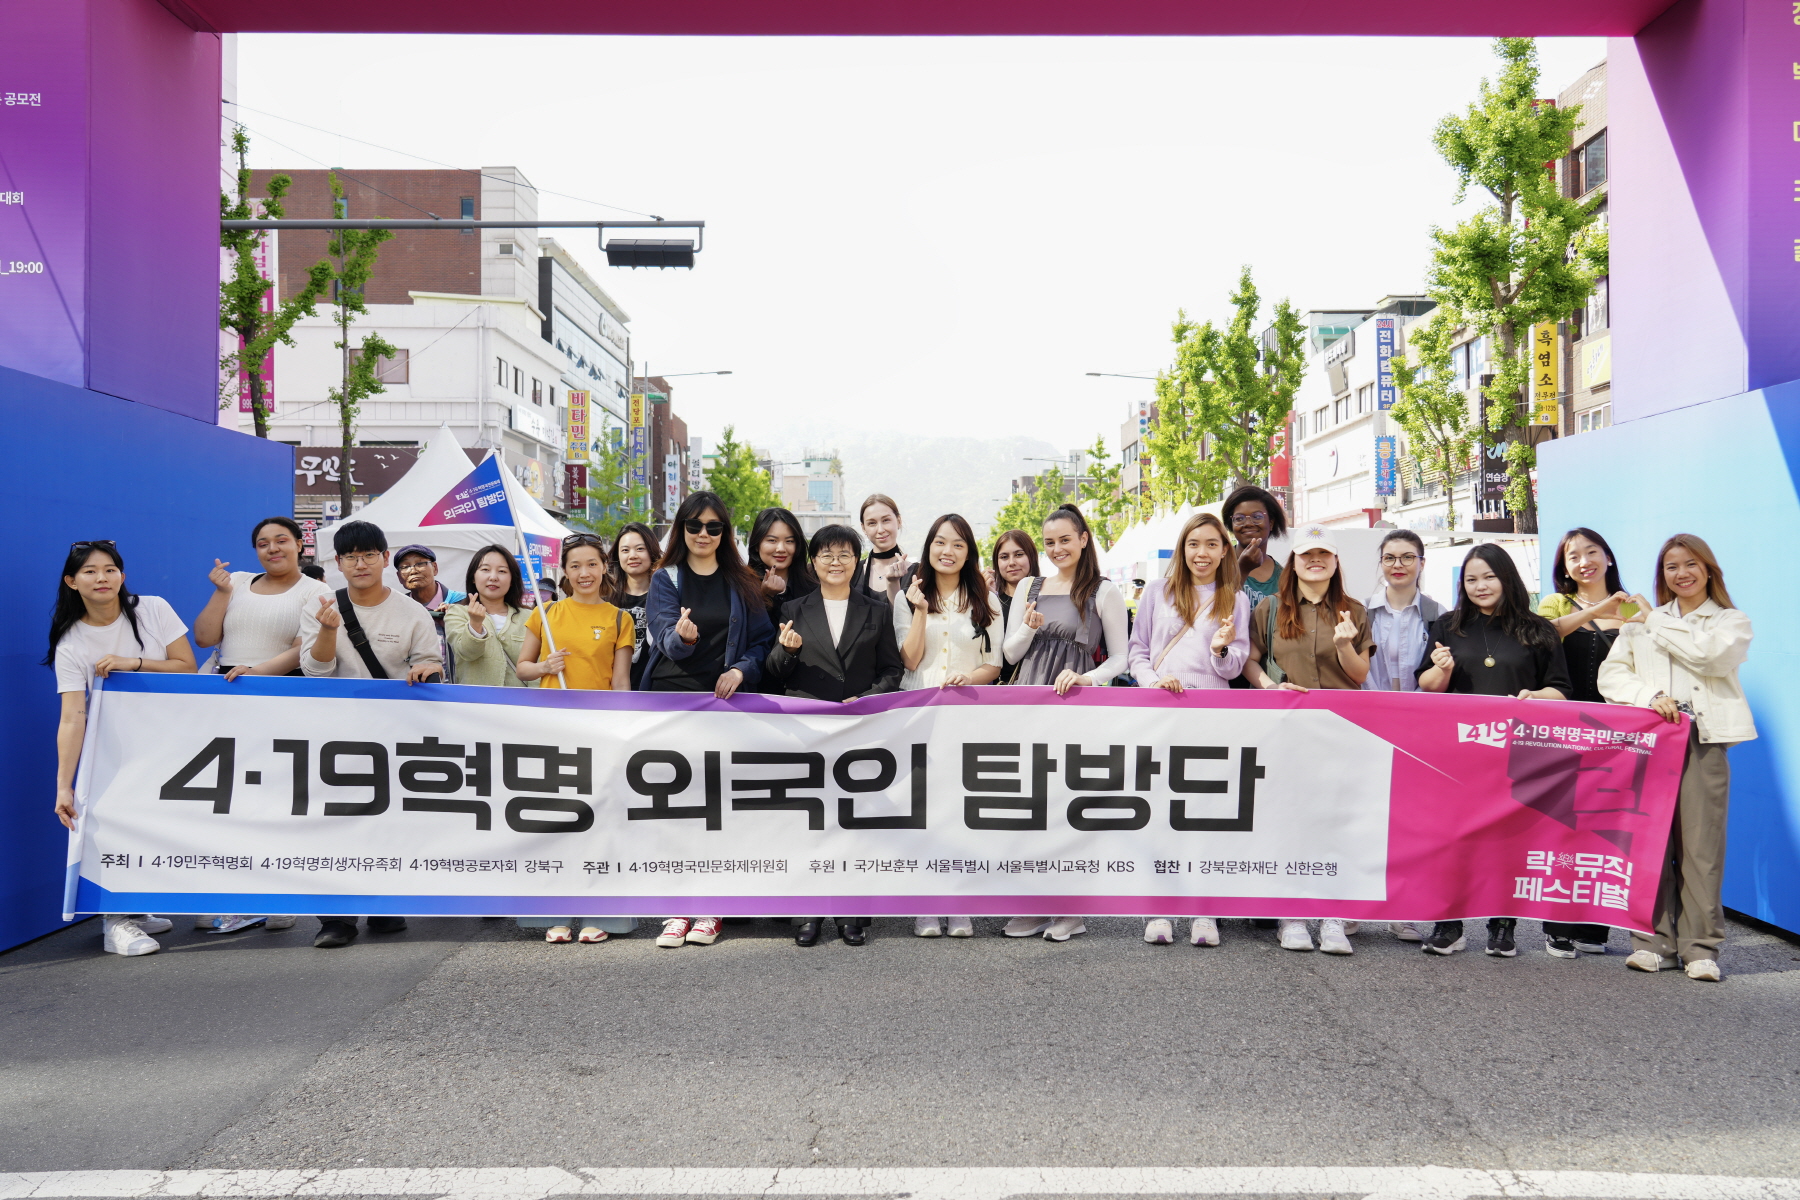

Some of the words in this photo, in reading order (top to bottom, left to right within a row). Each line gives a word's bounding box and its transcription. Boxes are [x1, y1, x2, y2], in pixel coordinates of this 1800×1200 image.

[4, 92, 41, 107] 공모전
[1537, 330, 1553, 387] 흑염소
[571, 392, 587, 440] 비타민
[632, 398, 641, 424] 전당포
[668, 460, 678, 495] 아리랑
[1485, 472, 1509, 483] 연습장
[443, 500, 477, 520] 외국인
[476, 490, 506, 509] 탐방단
[302, 520, 317, 543] 주점
[1513, 724, 1550, 739] 4·19
[1552, 725, 1658, 748] 혁명국민문화제
[1525, 740, 1562, 749] REVOLUTION
[1562, 743, 1593, 752] NATIONAL
[1624, 745, 1653, 755] FESTIVAL
[160, 736, 595, 834] 4·19혁명
[625, 743, 927, 832] 외국인
[962, 742, 1266, 832] 탐방단
[100, 854, 130, 868] 주최
[151, 855, 253, 871] 4·19민주혁명회
[260, 856, 402, 872] 4·19혁명희생자유족회
[410, 858, 518, 873] 4·19혁명공로자회
[524, 859, 564, 874] 강북구
[582, 860, 610, 875] 주관
[628, 859, 788, 874] 4·19혁명국민문화제위원회
[808, 860, 835, 874] 후원
[854, 859, 919, 873] 국가보훈부
[925, 859, 989, 874] 서울특별시
[996, 859, 1100, 874] 서울특별시교육청
[1107, 860, 1135, 873] KBS
[1154, 859, 1181, 874] 협찬
[1199, 860, 1278, 875] 강북문화재단
[1284, 861, 1338, 876] 신한은행
[1512, 877, 1630, 911] 페스티벌
